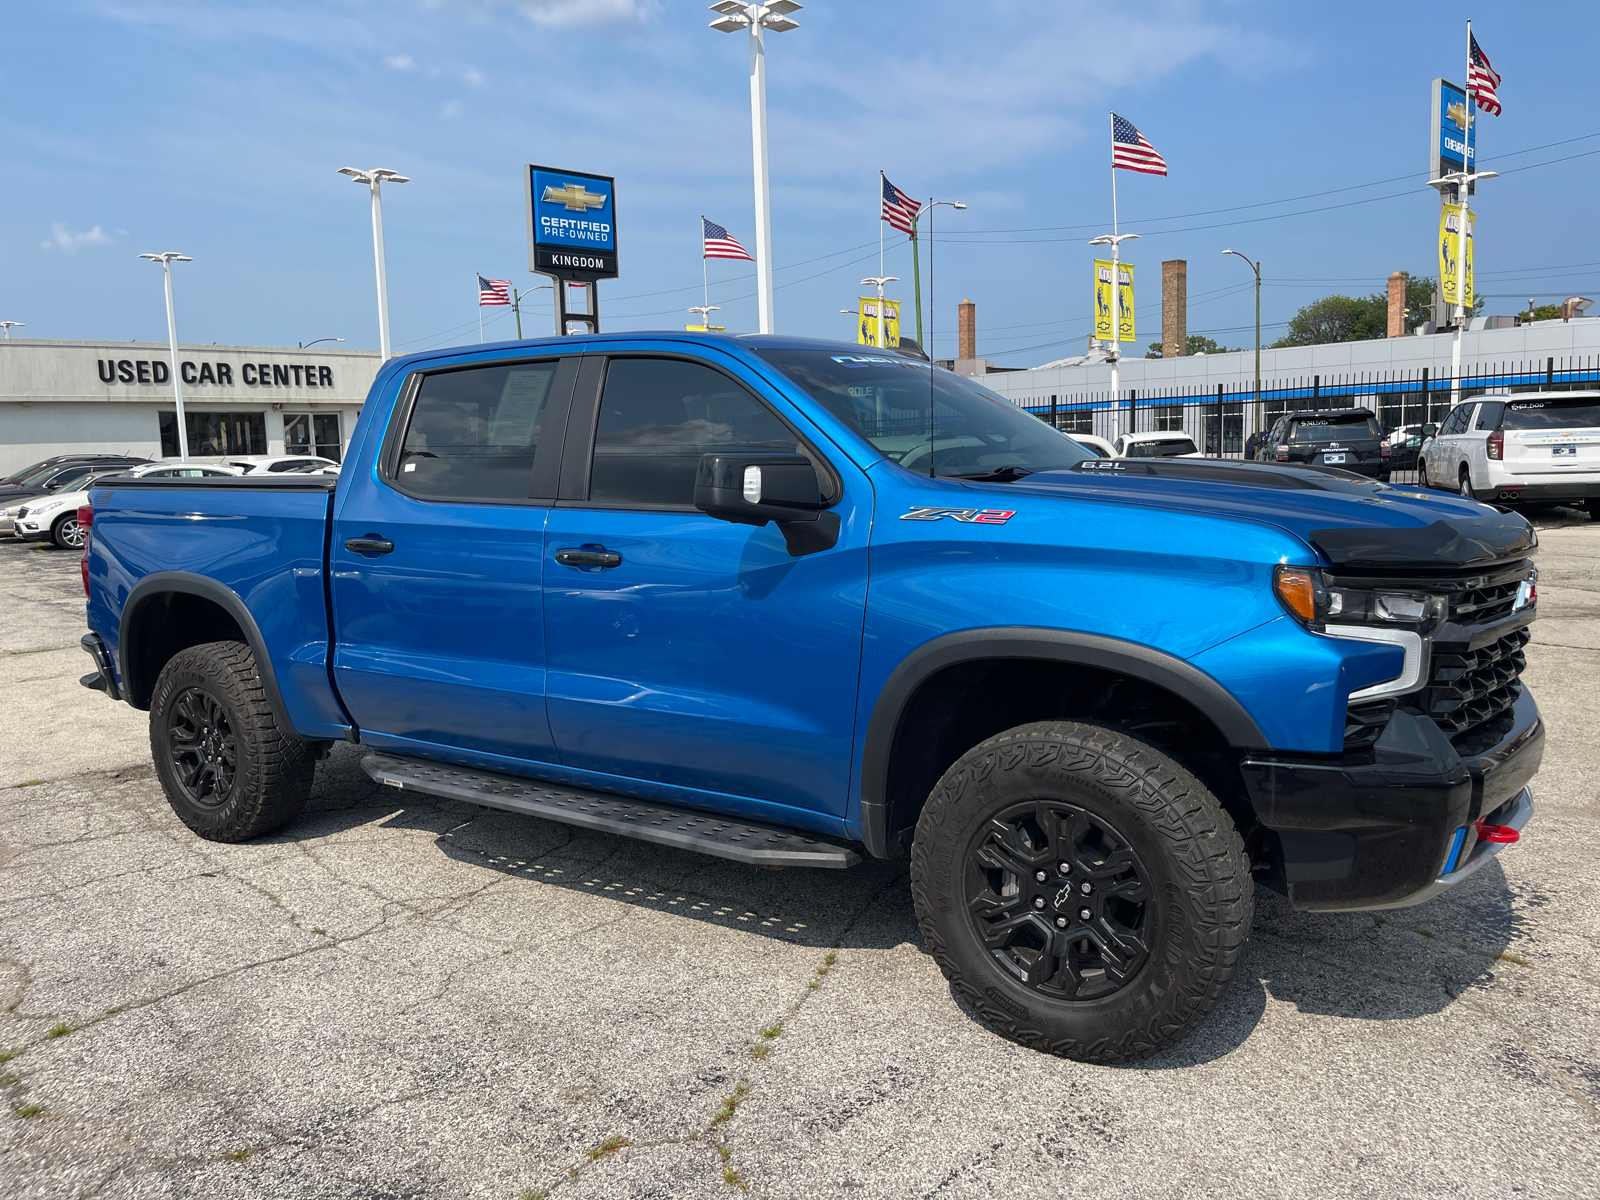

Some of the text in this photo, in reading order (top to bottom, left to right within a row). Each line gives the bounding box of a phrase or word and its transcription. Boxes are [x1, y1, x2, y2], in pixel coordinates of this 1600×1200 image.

[1444, 137, 1474, 159] CHEVROET
[541, 216, 610, 233] CERTIFIED
[544, 227, 608, 242] PRE-OWNED
[552, 254, 604, 269] KINGDOM
[97, 359, 333, 387] USED CAR CENTER
[1081, 461, 1126, 471] 6.2L
[899, 506, 1017, 525] ZR2
[935, 781, 1001, 914] WRANGLER
